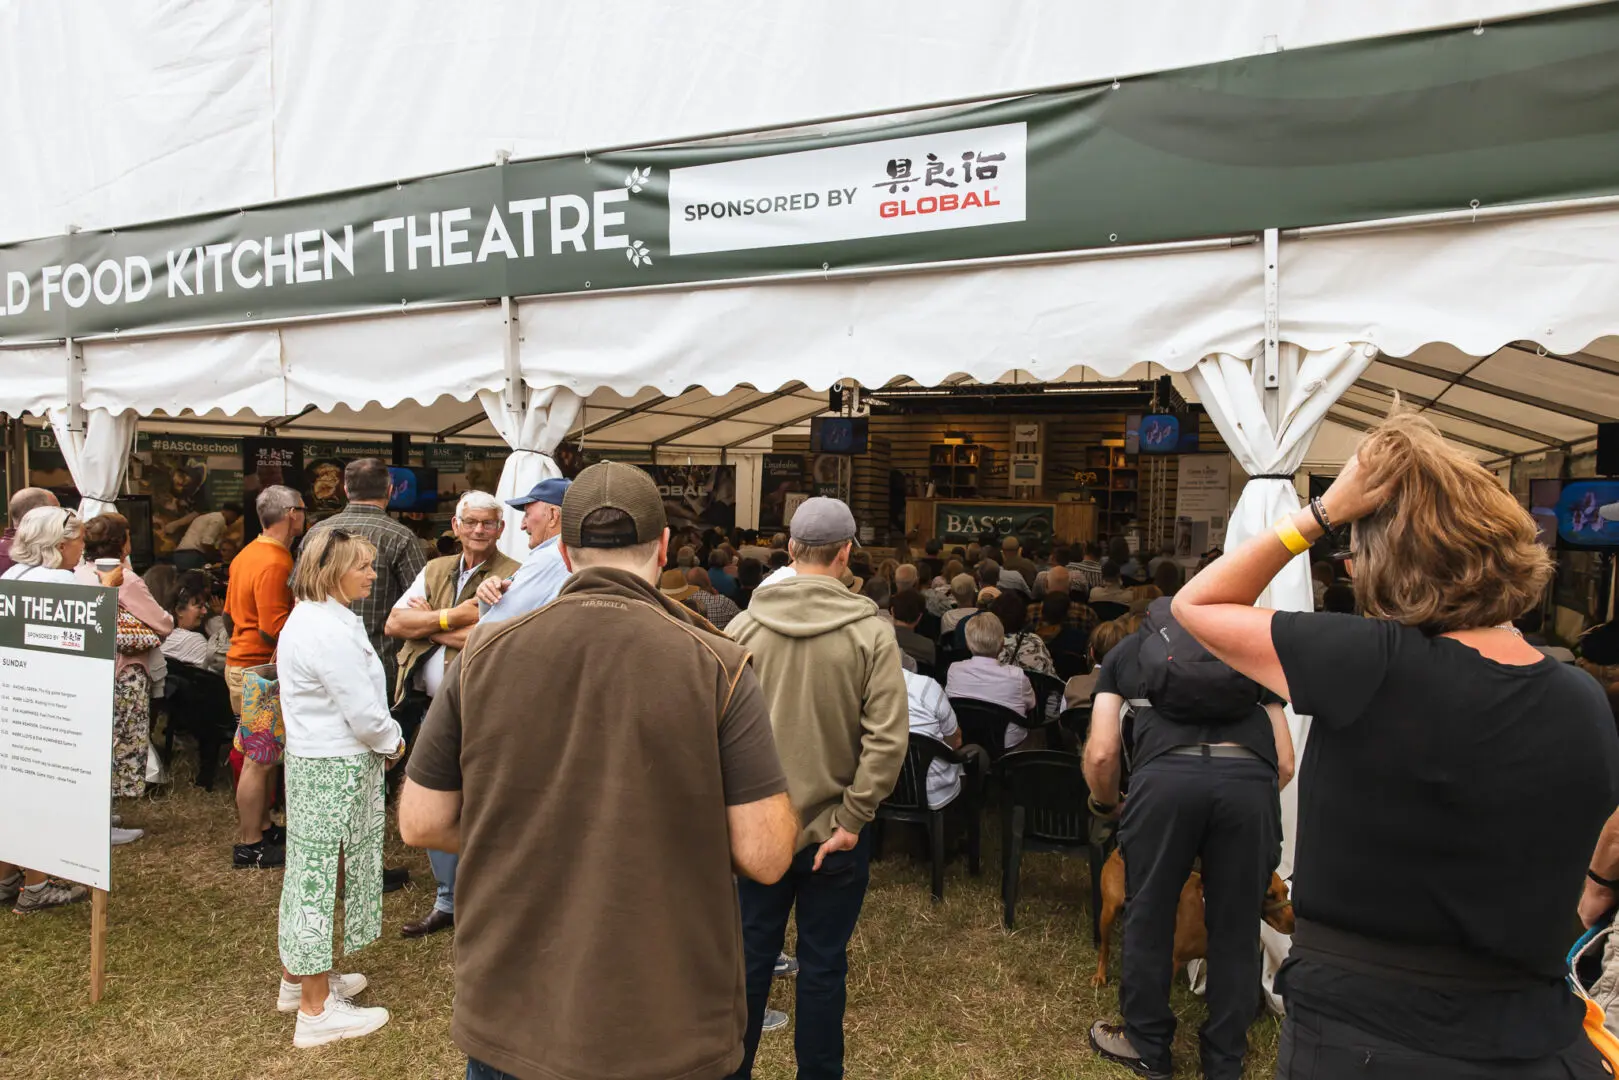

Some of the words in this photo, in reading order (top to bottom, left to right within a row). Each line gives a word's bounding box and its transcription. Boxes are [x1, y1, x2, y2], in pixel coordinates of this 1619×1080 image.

[684, 192, 820, 222] SPONSORED
[827, 187, 858, 207] BY
[879, 189, 1001, 218] GLOBAL
[42, 255, 153, 311] FOOD
[166, 225, 354, 298] KITCHEN
[373, 189, 630, 273] THEATRE
[152, 440, 238, 454] #BASCtoschool
[946, 515, 1013, 535] BASC
[22, 597, 97, 625] THEATRE
[2, 658, 27, 668] SUNDAY
